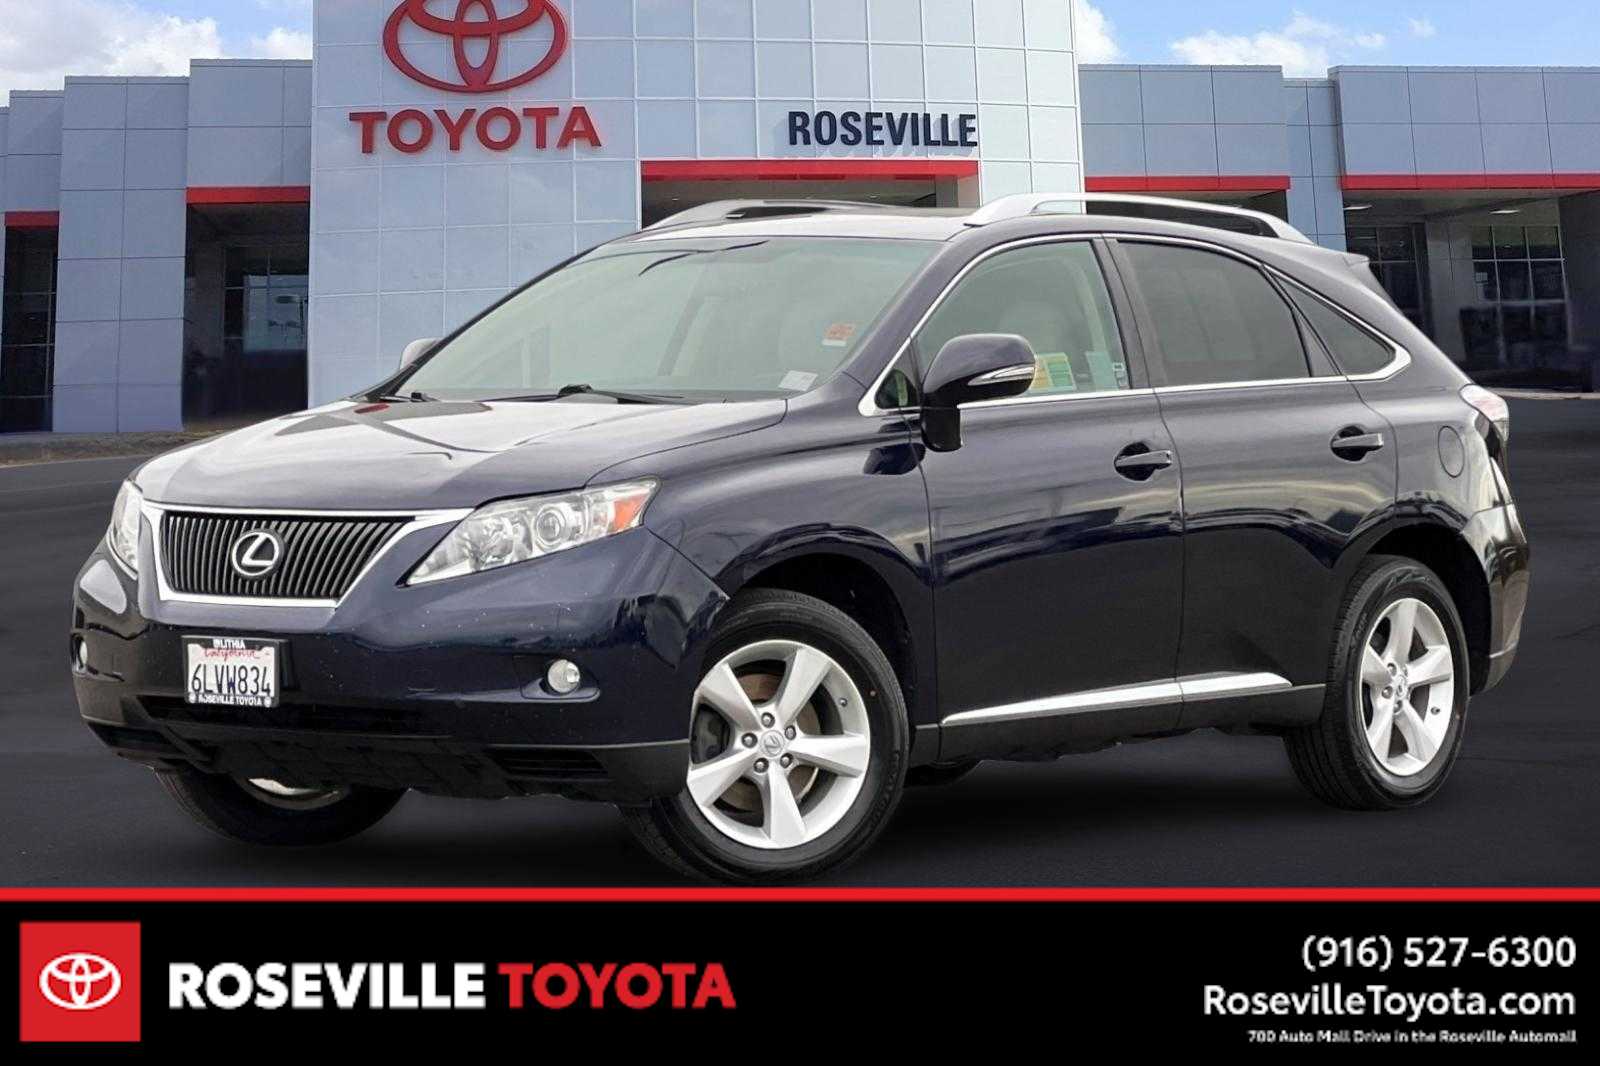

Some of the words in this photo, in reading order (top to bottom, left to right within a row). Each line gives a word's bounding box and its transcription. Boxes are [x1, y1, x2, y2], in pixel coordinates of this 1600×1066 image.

[349, 106, 602, 154] TOYOTA
[788, 111, 978, 147] ROSEVILLE
[191, 663, 271, 696] 6LVW834
[198, 694, 234, 705] ROSEVILLE
[236, 696, 262, 706] TOYOTA
